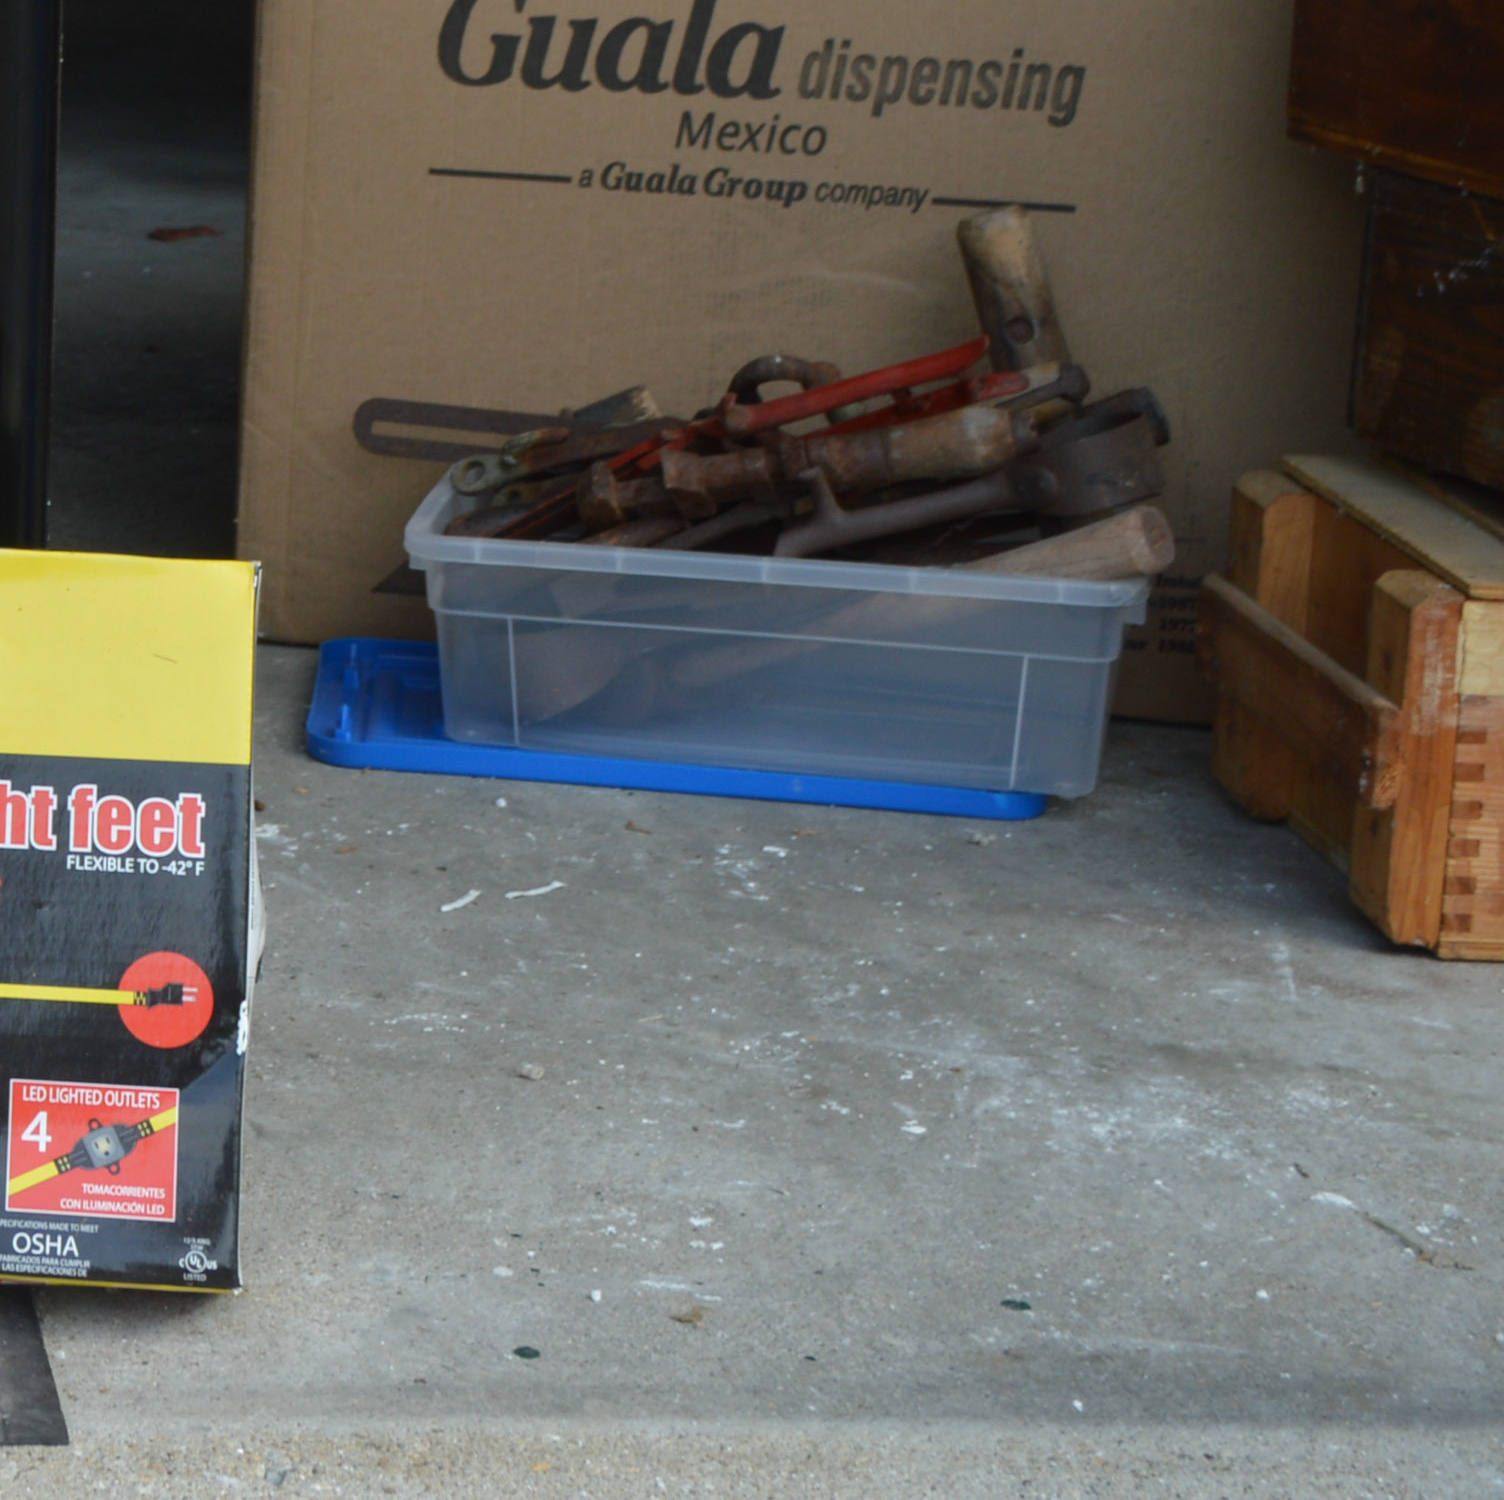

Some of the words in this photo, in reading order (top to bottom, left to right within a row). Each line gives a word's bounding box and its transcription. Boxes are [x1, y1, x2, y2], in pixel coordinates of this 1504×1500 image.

[797, 39, 1086, 128] dispensing
[675, 111, 828, 156] Mexico
[579, 167, 593, 188] a
[600, 161, 699, 197] Guala
[703, 167, 808, 205] Group
[815, 181, 929, 214] company
[68, 784, 206, 858] feet
[66, 854, 135, 872] FLEXIBLE
[138, 858, 159, 874] TO
[195, 860, 205, 876] F
[22, 1085, 47, 1102] LED
[49, 1087, 103, 1106] LIGHTED
[105, 1090, 160, 1109] OUTLETS
[21, 1111, 52, 1153] 4
[82, 1183, 165, 1199] TOMACORRIENTES
[60, 1198, 81, 1210] CON
[82, 1199, 145, 1215] ILUMINACIÓN
[147, 1203, 165, 1215] LED
[49, 1221, 69, 1232] MADE
[12, 1232, 79, 1257] OSHA
[41, 1255, 59, 1267] PARA
